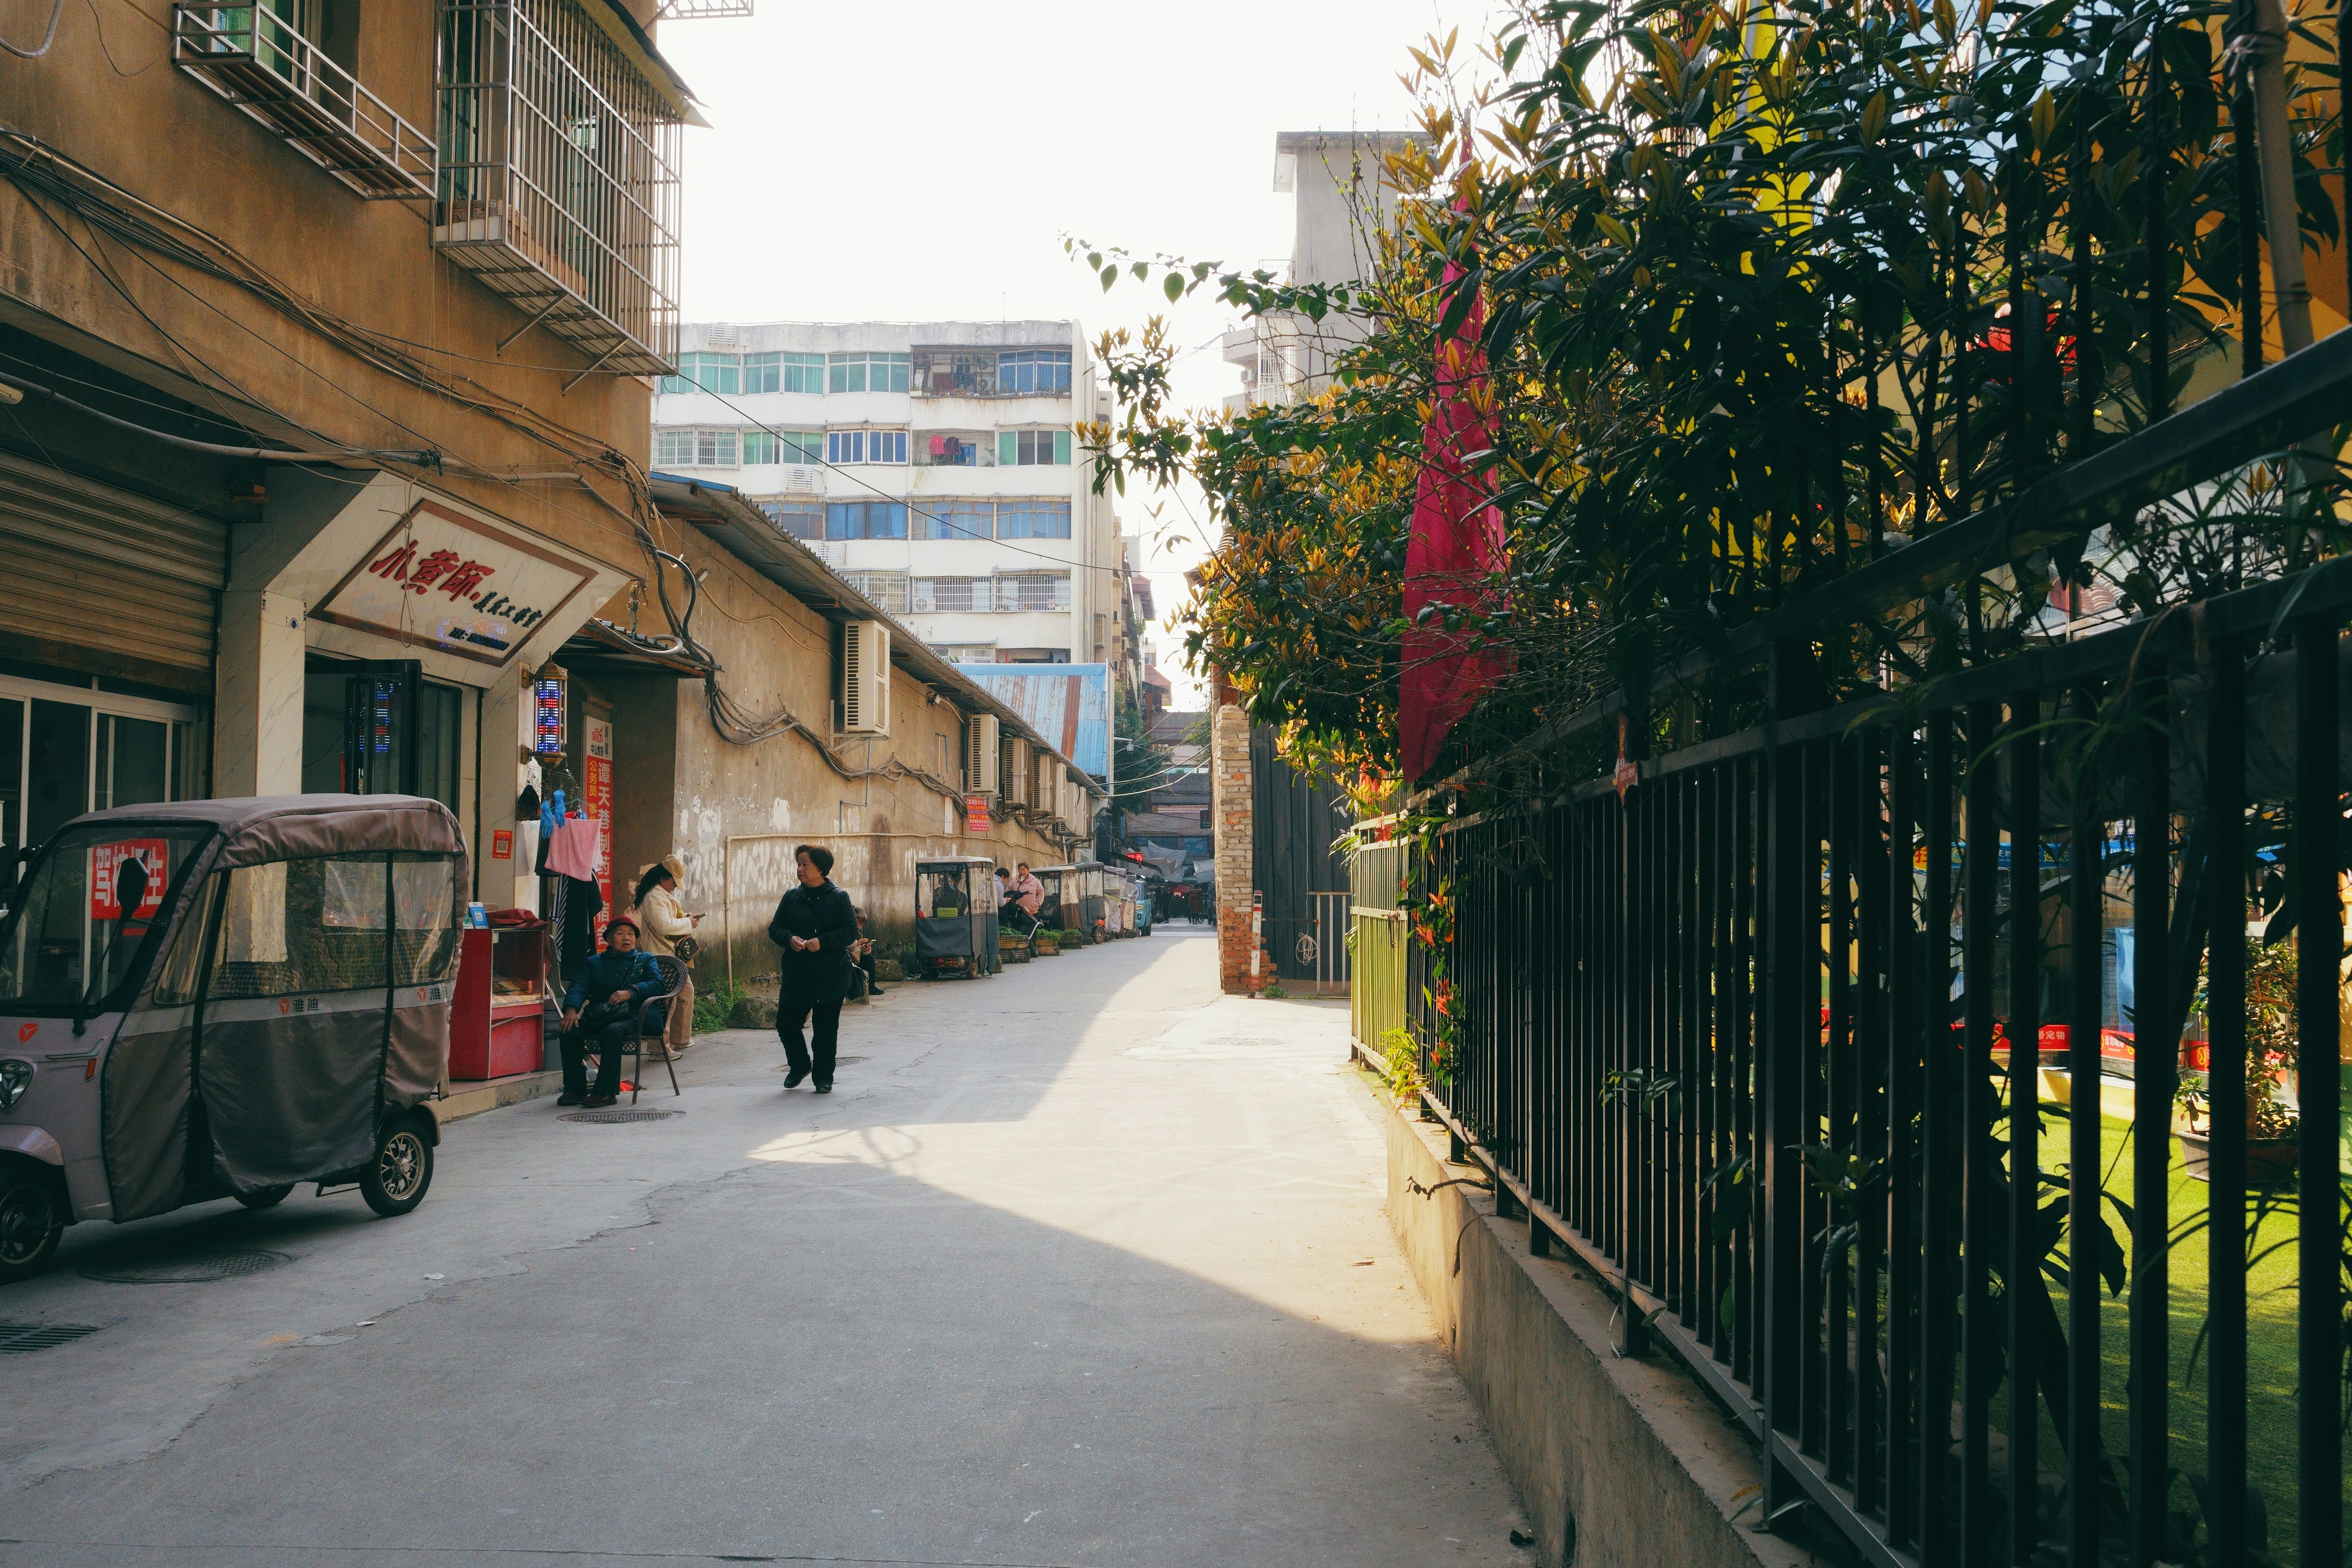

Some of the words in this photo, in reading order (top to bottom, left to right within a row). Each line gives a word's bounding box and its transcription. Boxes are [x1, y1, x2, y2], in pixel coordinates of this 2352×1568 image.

[591, 743, 604, 757] 中公教育
[292, 997, 318, 1012] 雅迪
